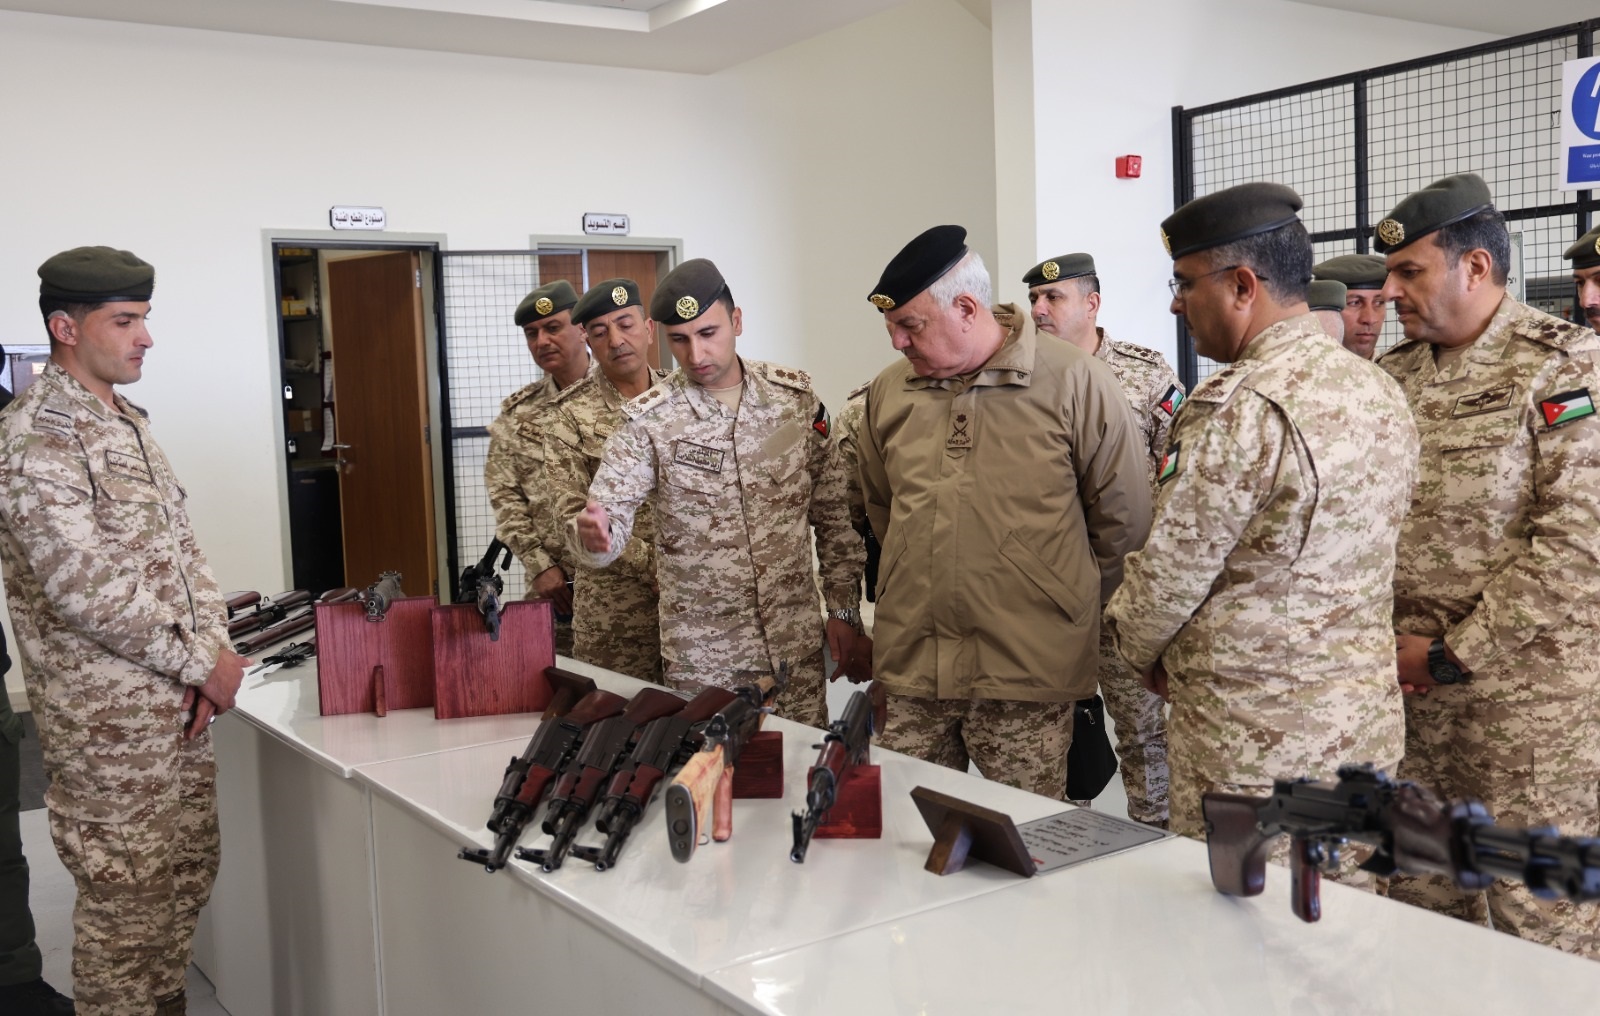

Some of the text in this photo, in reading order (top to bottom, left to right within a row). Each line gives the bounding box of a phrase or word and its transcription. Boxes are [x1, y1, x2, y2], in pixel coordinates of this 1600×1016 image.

[334, 211, 383, 226] مستودع القطع الفنية
[587, 218, 626, 231] قسم التسويد
